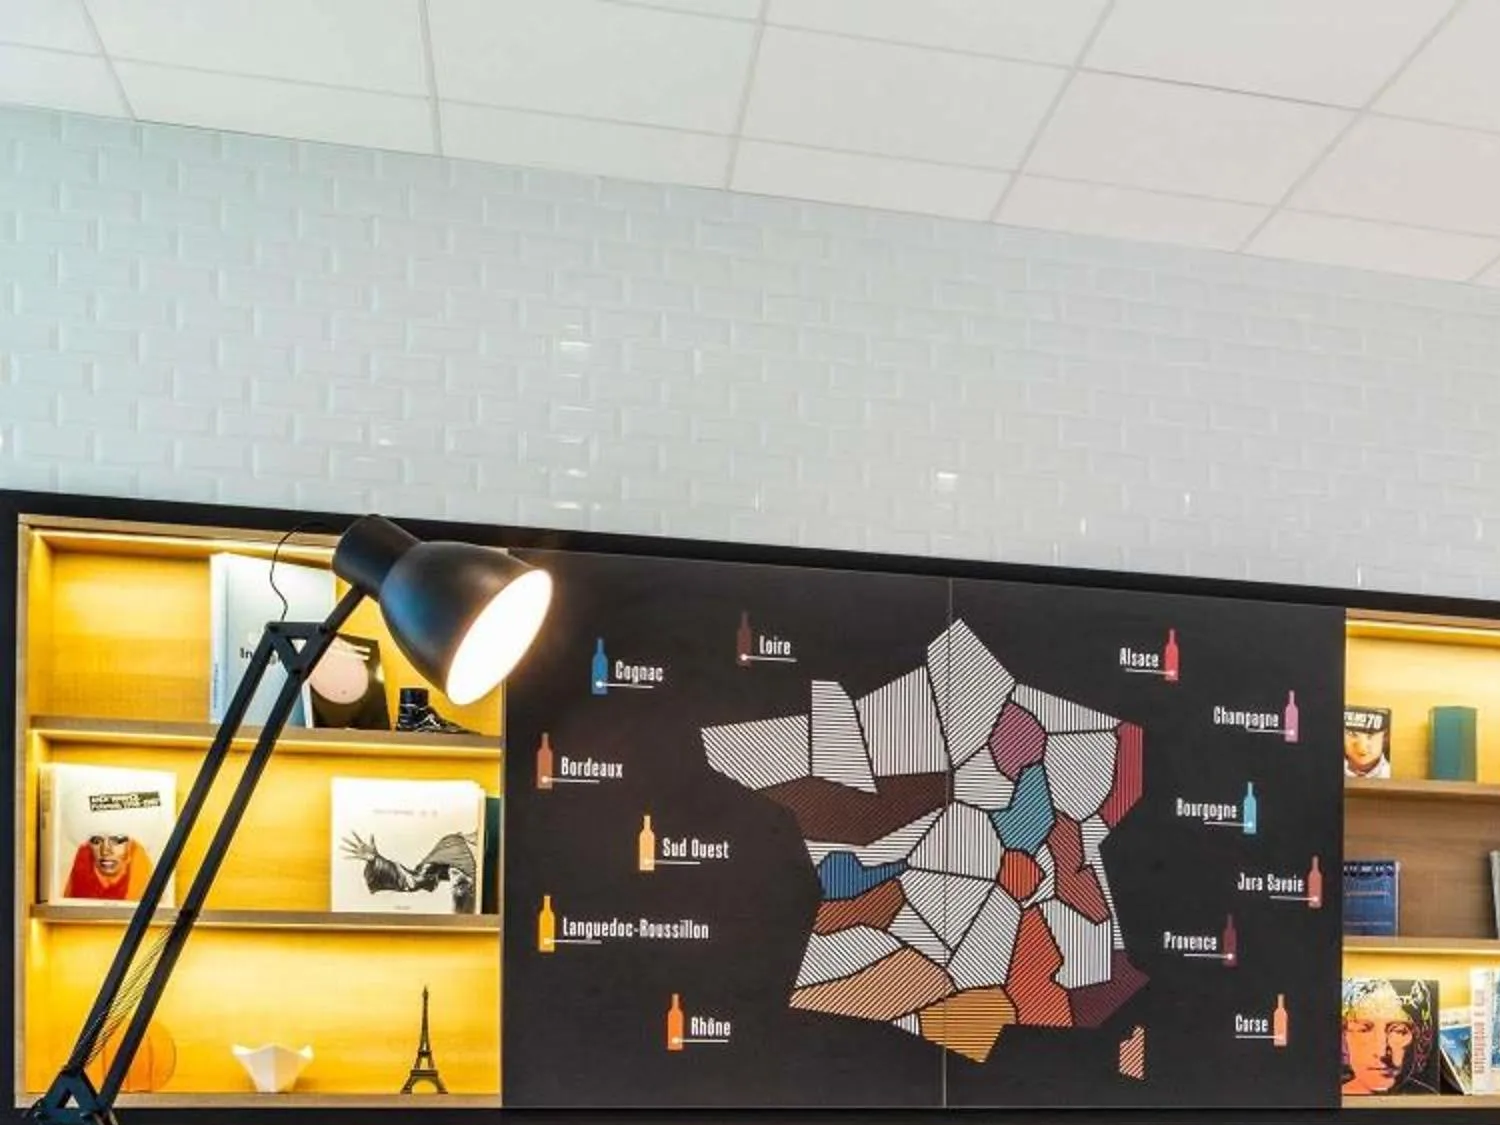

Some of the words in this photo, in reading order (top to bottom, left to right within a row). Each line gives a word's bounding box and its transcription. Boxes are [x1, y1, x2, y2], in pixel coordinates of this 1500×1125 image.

[759, 635, 791, 656] Loire
[1119, 648, 1159, 668] Alsace
[615, 660, 664, 683] Cognac
[1213, 706, 1279, 729] Champagne
[561, 757, 623, 778] Bordeaux
[1176, 798, 1237, 820] Bourgogne
[662, 838, 687, 858] Sud
[691, 839, 729, 859] Ouest
[1237, 872, 1263, 891] Jura
[1267, 874, 1305, 893] Savoie
[562, 918, 710, 941] Languedoc-Roussillon
[1163, 931, 1217, 951] Provence
[691, 1016, 731, 1036] Rhône
[1235, 1014, 1268, 1034] Corse
